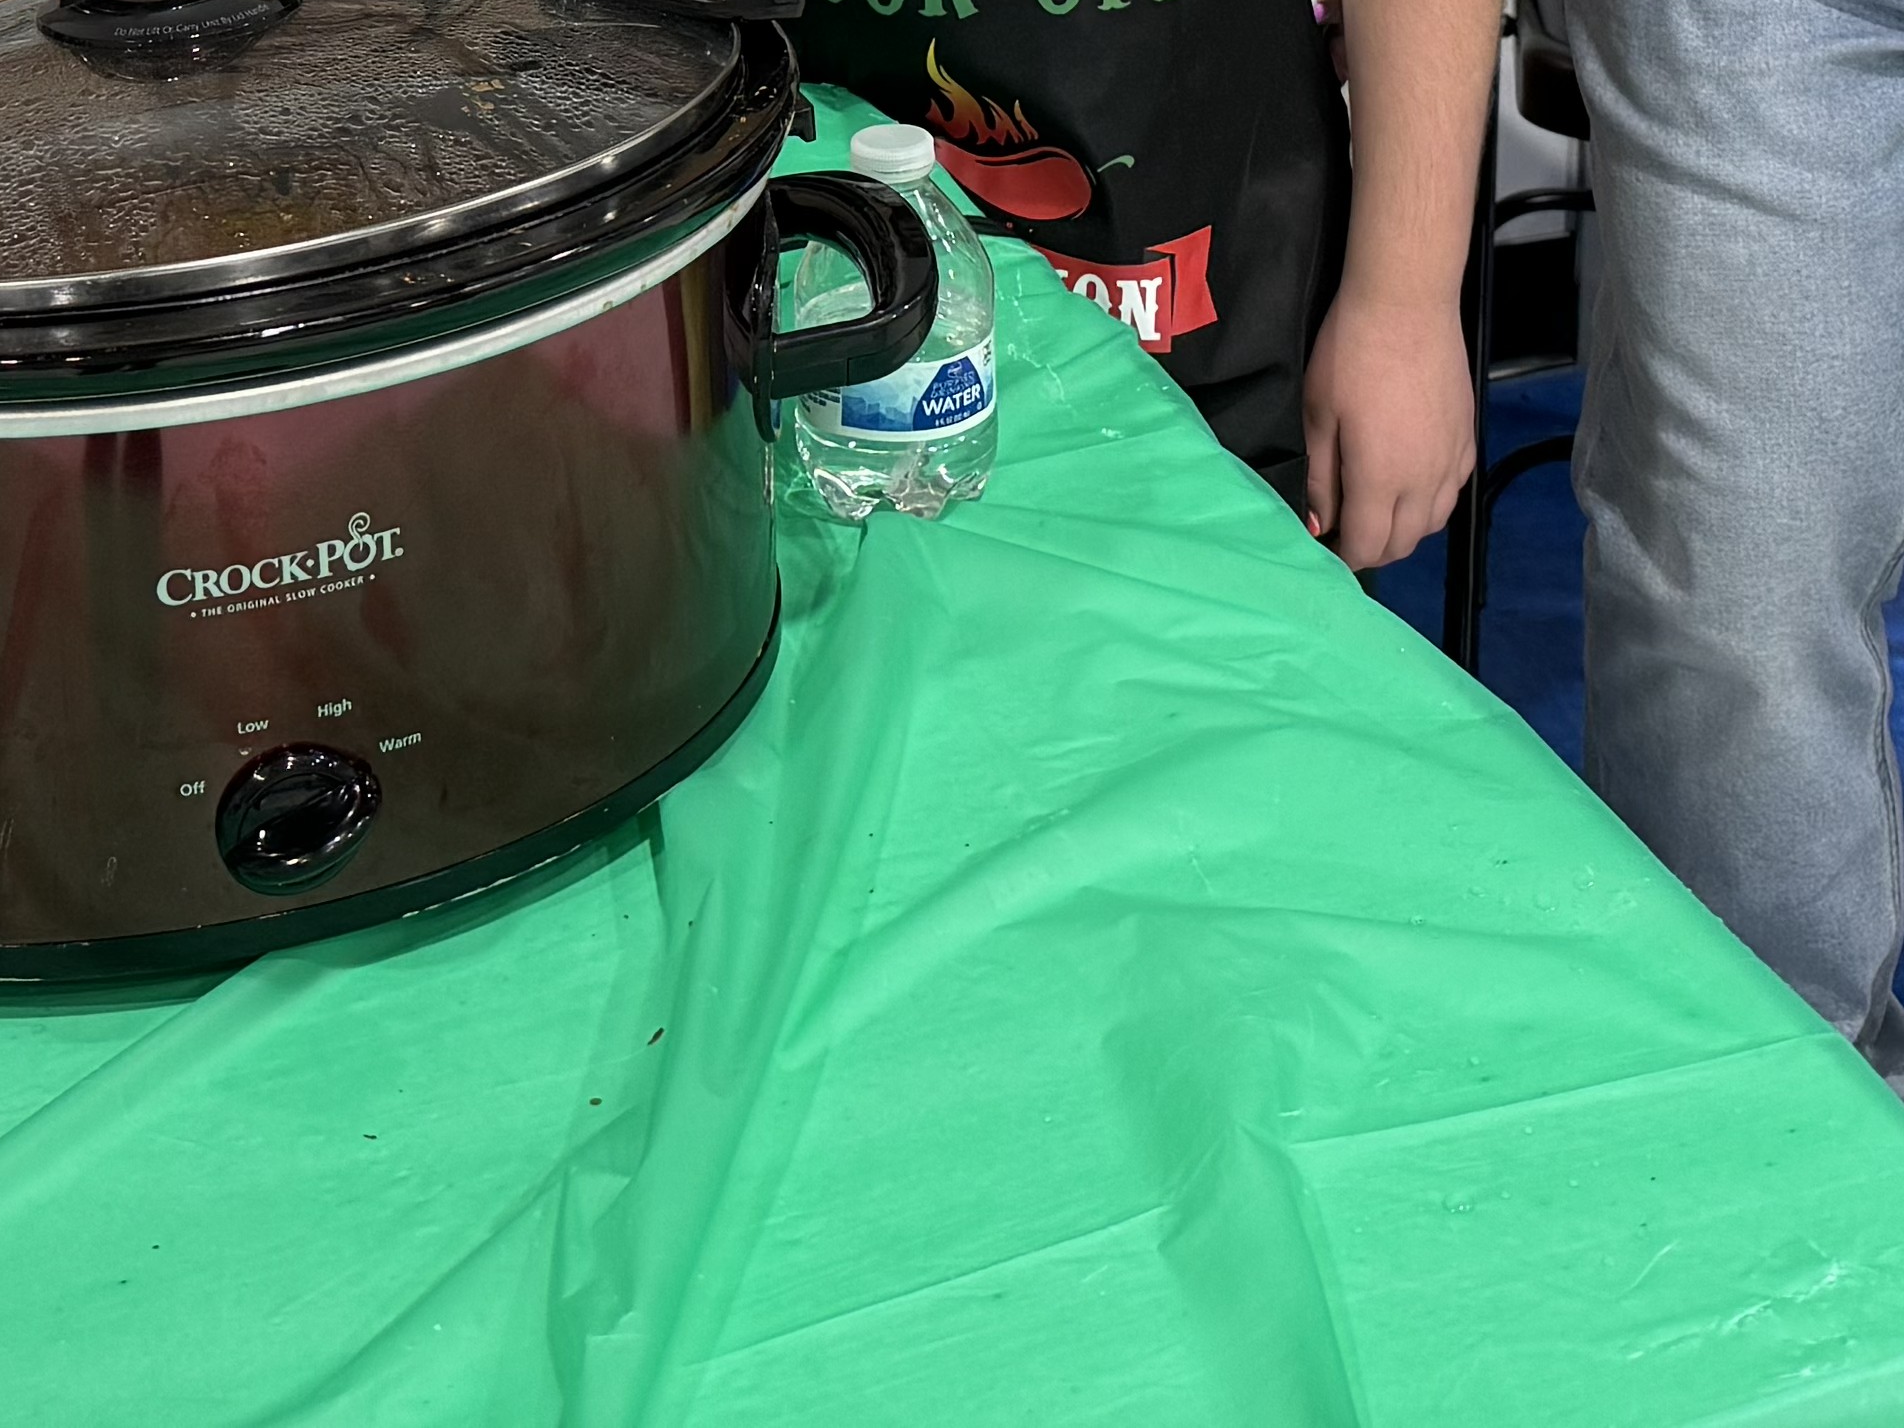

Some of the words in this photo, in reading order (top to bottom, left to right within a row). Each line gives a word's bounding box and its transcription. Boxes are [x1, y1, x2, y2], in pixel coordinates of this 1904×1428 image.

[922, 383, 982, 417] WATER
[201, 605, 223, 618] THE
[226, 595, 281, 613] ORIGINAL
[285, 587, 317, 603] SLOW
[319, 575, 365, 594] COOKER
[316, 697, 353, 719] High
[237, 717, 270, 735] Low
[378, 730, 423, 754] Warm
[179, 780, 206, 797] Off
